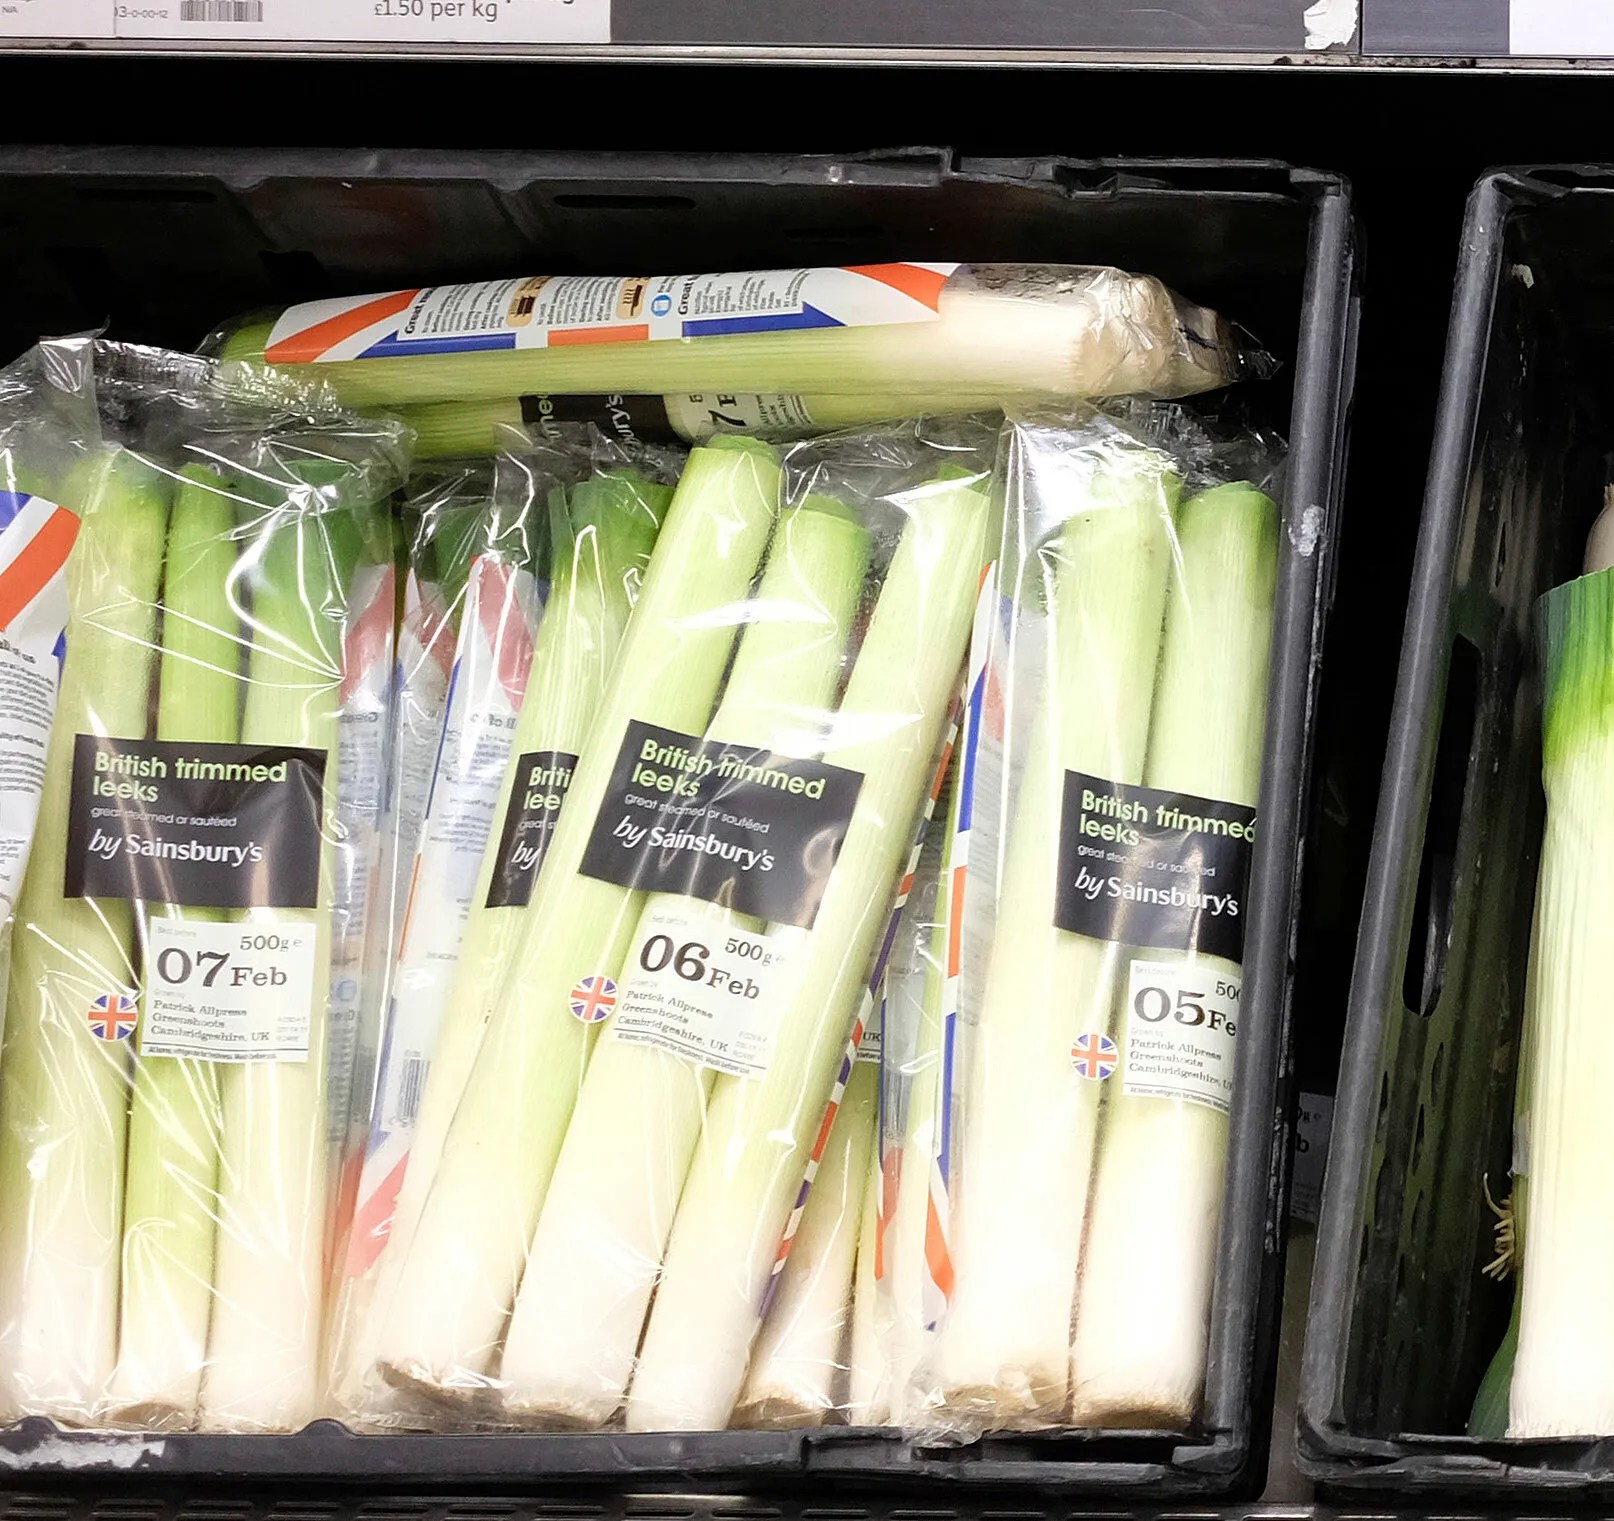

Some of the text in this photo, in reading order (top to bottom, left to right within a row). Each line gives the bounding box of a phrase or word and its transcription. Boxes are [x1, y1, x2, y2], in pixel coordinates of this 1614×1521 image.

[430, 0, 465, 22] per
[95, 752, 288, 782] British trimmed
[528, 765, 572, 789] Briti
[631, 763, 702, 798] leeks
[640, 739, 828, 800] British trimmed
[92, 775, 159, 803] leeks
[523, 790, 561, 812] lee
[624, 793, 771, 835] great sautéed
[1081, 789, 1149, 824] British
[613, 815, 776, 873] by Sainsbury's
[1079, 813, 1140, 847] leeks
[88, 829, 264, 868] by Sainsbury's
[511, 840, 542, 871] by
[1077, 844, 1105, 859] great
[1074, 865, 1239, 917] by Sainsbury's
[240, 935, 290, 952] 500g
[725, 937, 773, 967] 500g
[157, 947, 288, 988] 07 Feb
[640, 934, 760, 1000] 06 Feb
[153, 1000, 248, 1018] Patrick Allpress
[626, 990, 665, 1004] Patrick
[1134, 986, 1237, 1037] 05 Fe
[251, 1032, 270, 1042] UK
[710, 1039, 729, 1053] UK
[1130, 1038, 1175, 1052] Patrick
